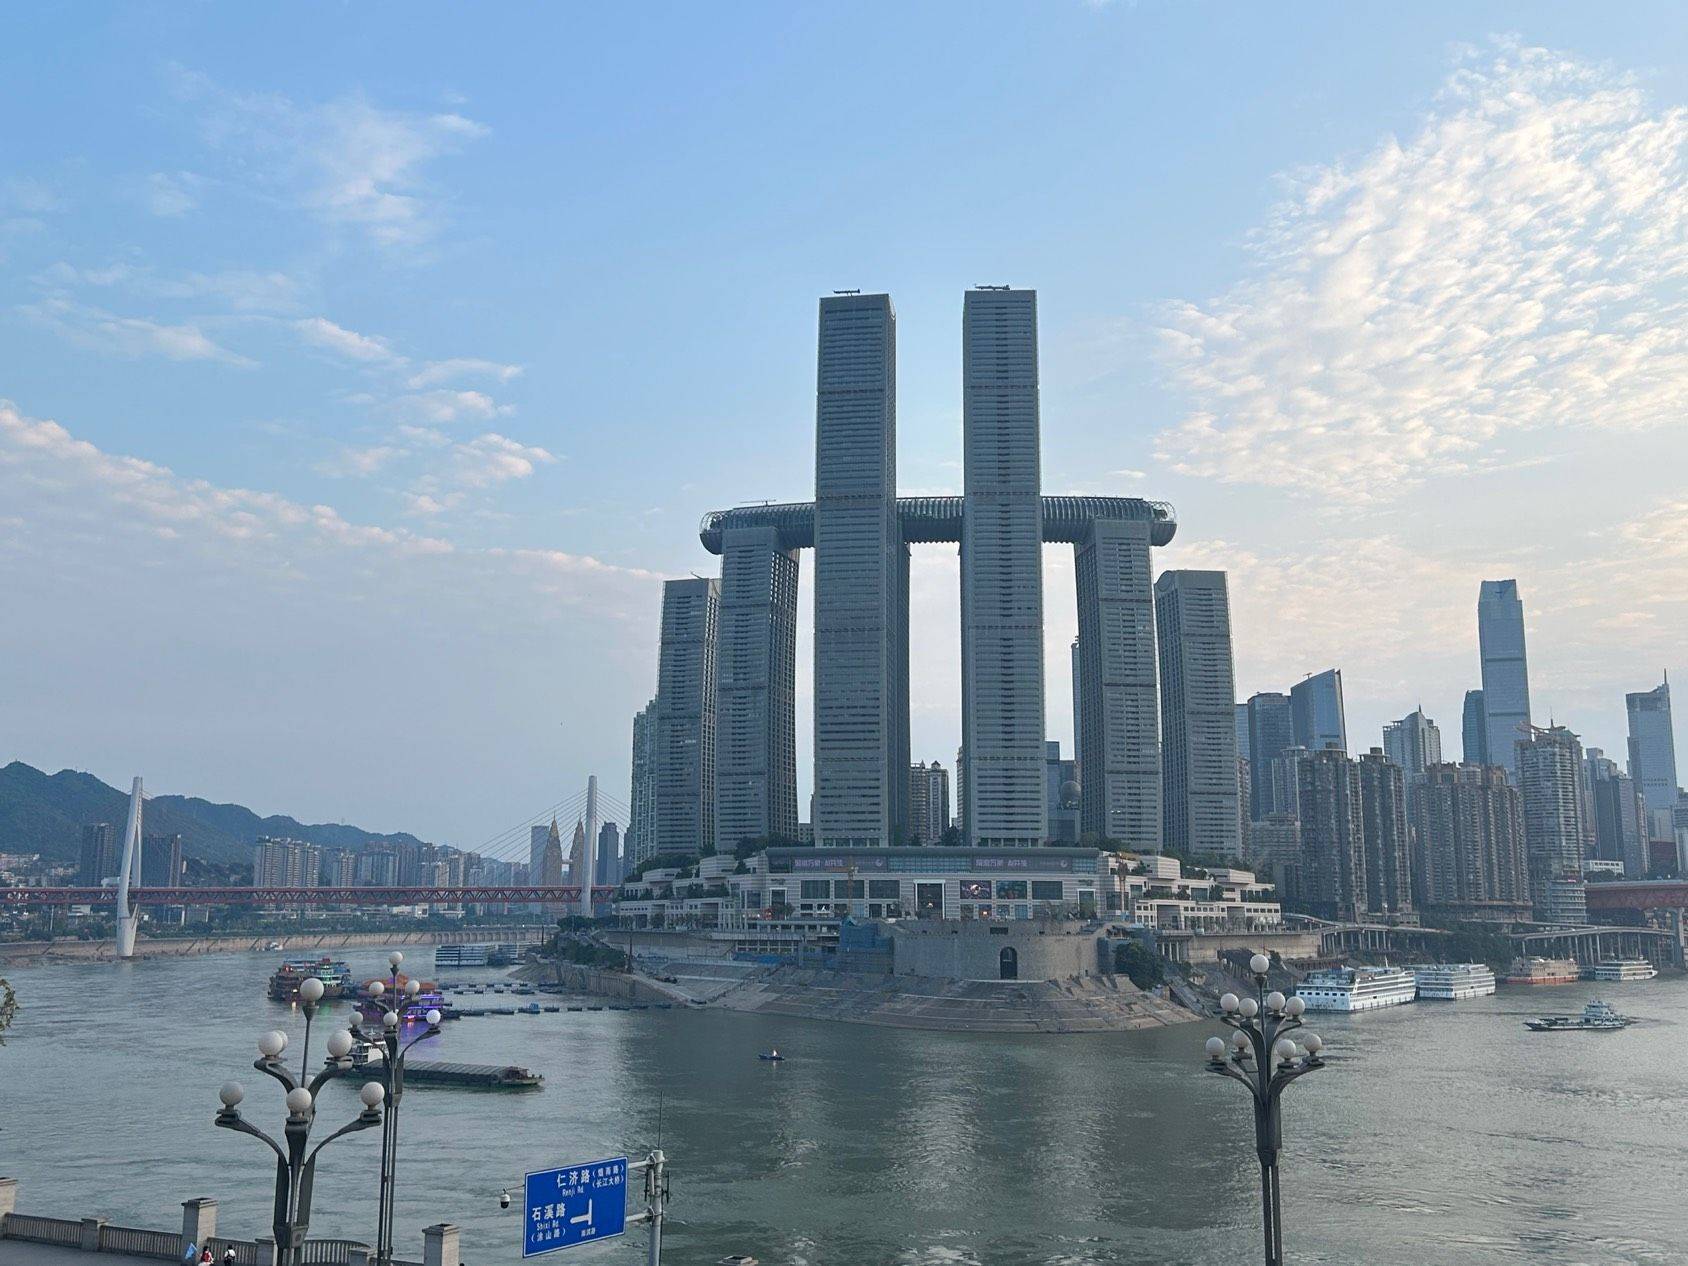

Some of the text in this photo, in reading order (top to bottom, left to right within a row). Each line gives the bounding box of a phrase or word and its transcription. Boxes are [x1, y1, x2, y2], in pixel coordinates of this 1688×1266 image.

[557, 1169, 590, 1188] 仁济路
[562, 1188, 575, 1197] Renji
[532, 1202, 566, 1221] 石溪路
[537, 1221, 550, 1231] Shixi
